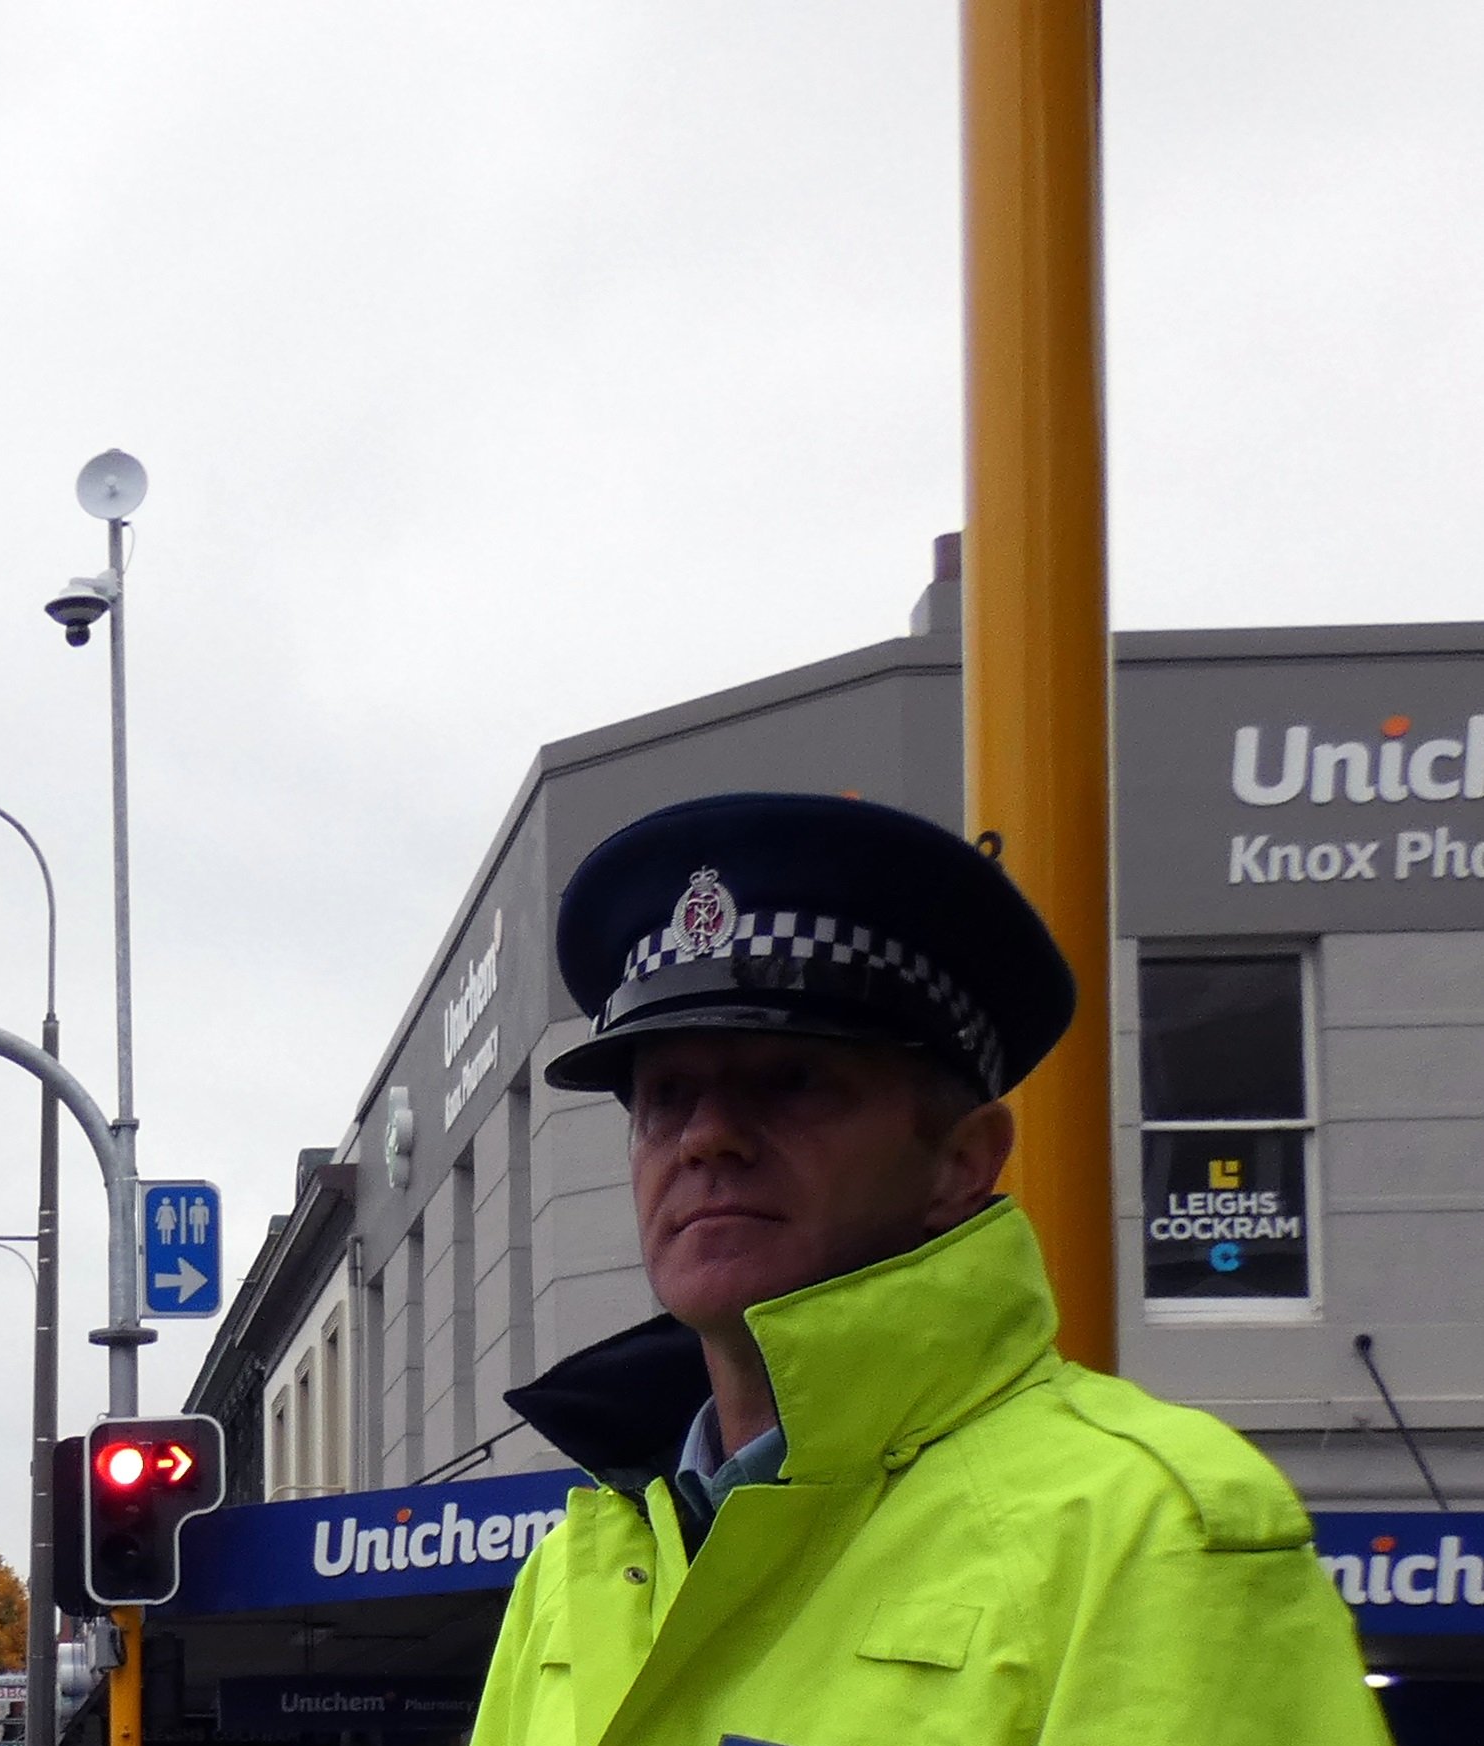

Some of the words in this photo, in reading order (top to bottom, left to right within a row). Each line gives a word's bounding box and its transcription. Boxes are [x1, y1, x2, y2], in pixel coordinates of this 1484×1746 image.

[1228, 834, 1380, 884] Knox
[1169, 1191, 1279, 1216] LEIGHS
[1150, 1215, 1301, 1240] COCKRAM
[1317, 1535, 1484, 1606] nich
[281, 1691, 385, 1713] Unichem
